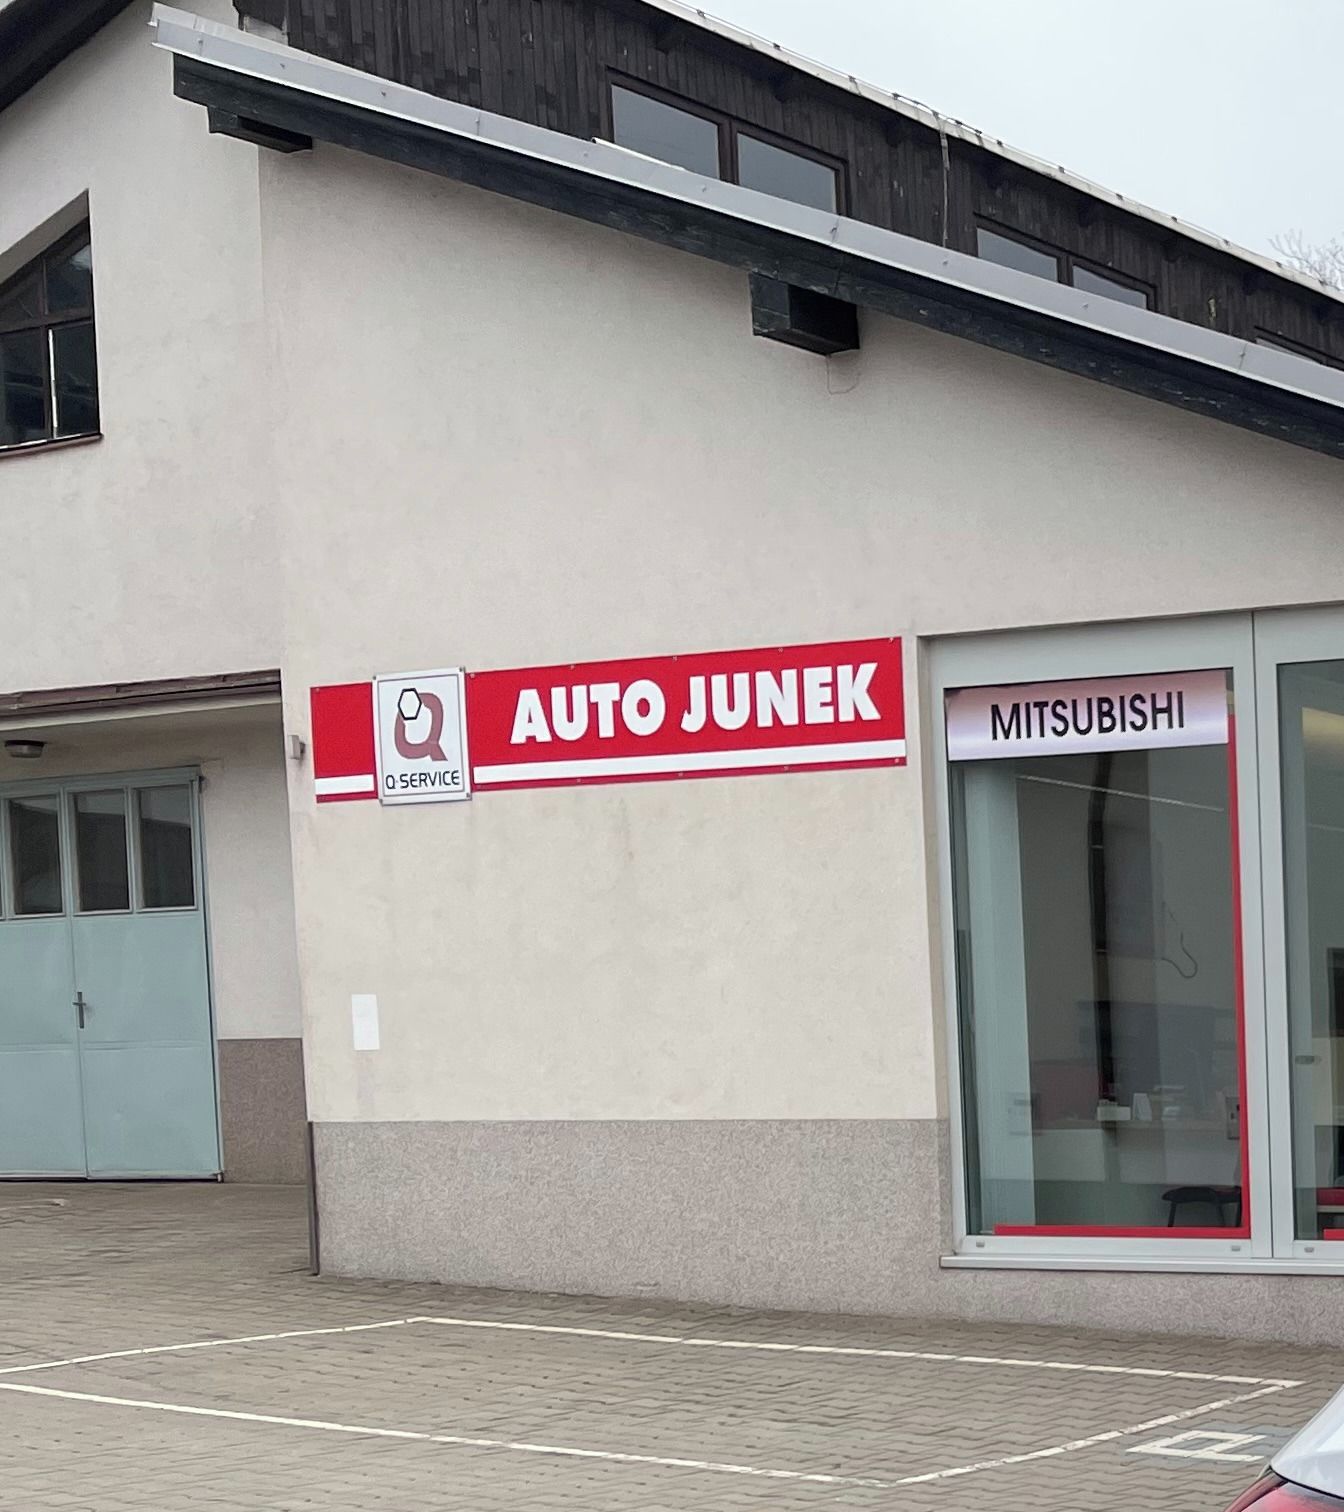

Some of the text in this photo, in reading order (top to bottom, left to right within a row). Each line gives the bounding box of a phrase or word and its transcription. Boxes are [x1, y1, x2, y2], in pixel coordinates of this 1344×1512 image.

[510, 662, 882, 745] AUTO JUNEK
[990, 691, 1185, 741] MITSUBISHI
